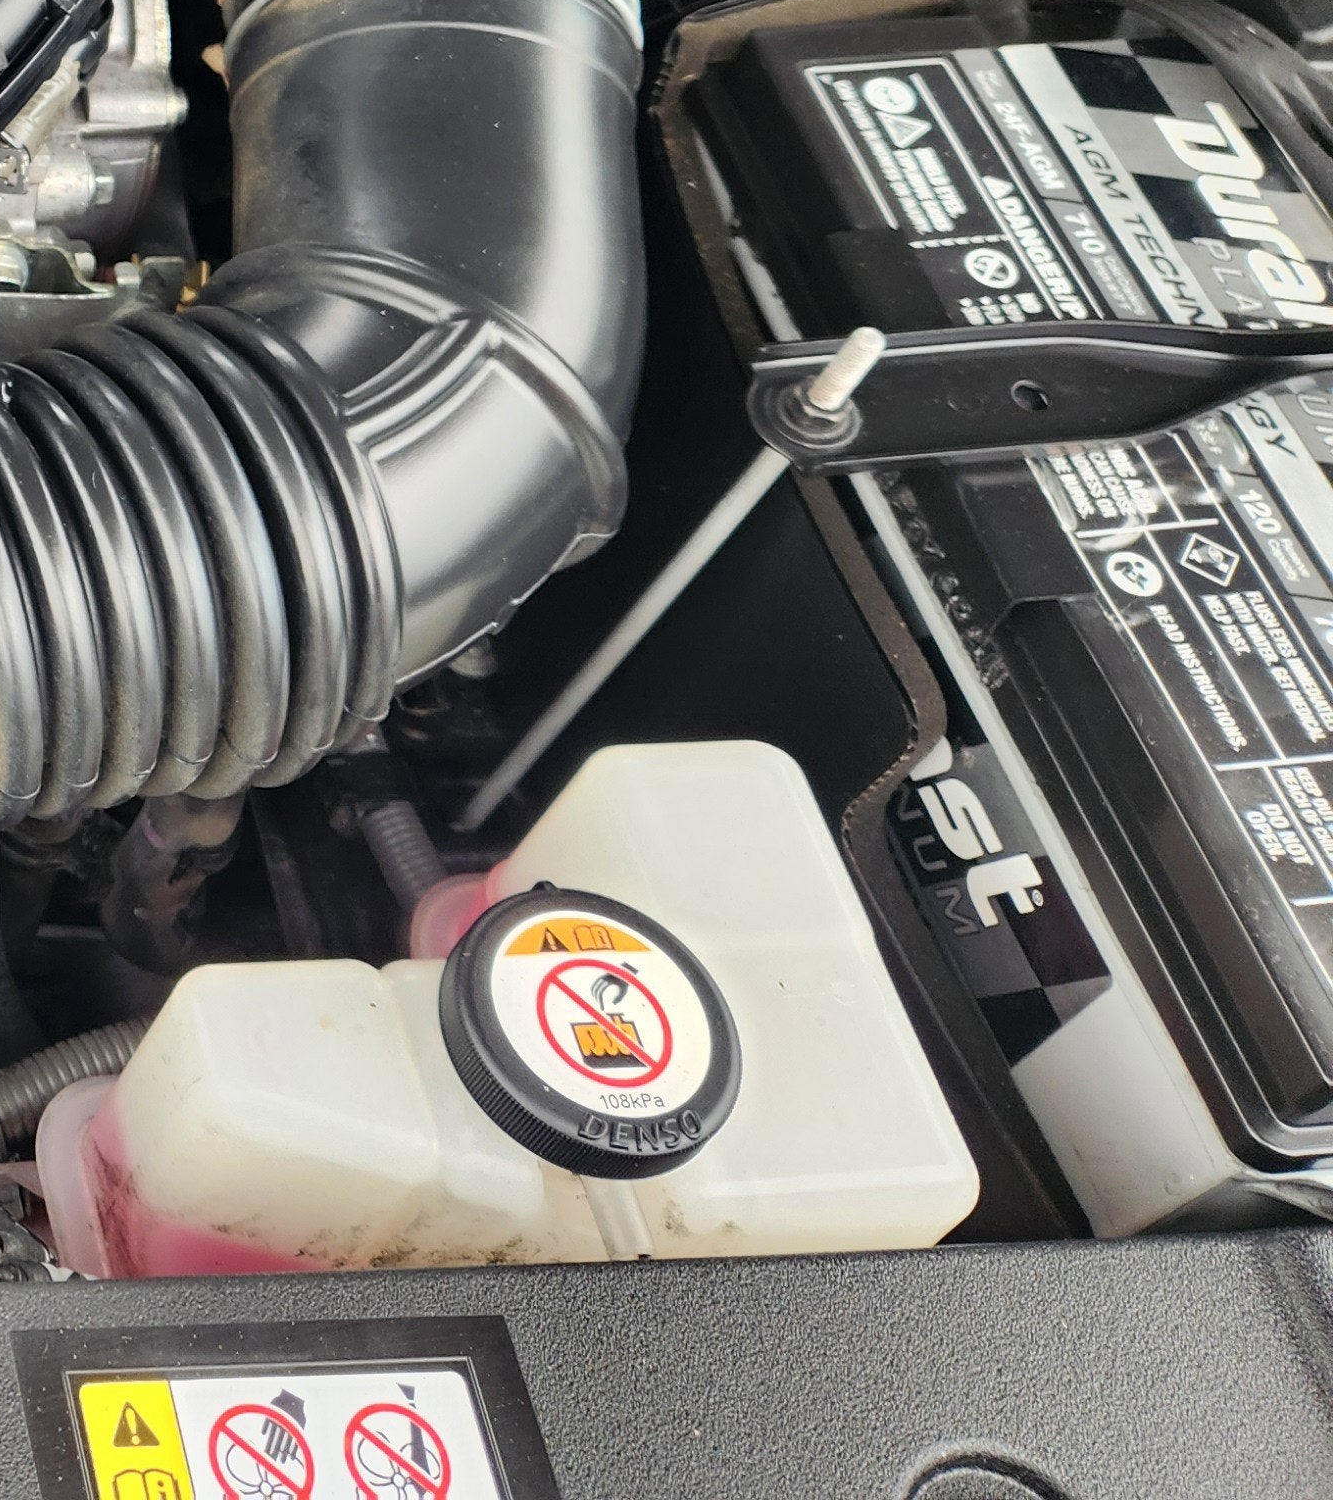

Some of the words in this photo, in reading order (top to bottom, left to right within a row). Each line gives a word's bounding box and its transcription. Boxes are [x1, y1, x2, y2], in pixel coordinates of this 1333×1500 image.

[1063, 125, 1132, 200] AGM
[1063, 210, 1108, 256] 710
[1152, 101, 1333, 327] Dural
[1235, 491, 1282, 534] 120
[1201, 595, 1232, 624] HELP
[1245, 591, 1280, 628] FLUSH
[1267, 628, 1298, 658] EYES
[1149, 605, 1186, 641] READ
[1172, 641, 1248, 752] INSTRUCTIONS.
[1225, 593, 1256, 622] WITH
[1270, 666, 1297, 690] GET
[1284, 690, 1326, 743] MEDICAL
[1277, 770, 1312, 808] REACH
[1300, 810, 1322, 827] OF
[1293, 767, 1324, 797] KEEP
[1243, 811, 1287, 863] OPEN.
[1261, 803, 1290, 829] DO
[1277, 830, 1314, 864] NOT
[599, 1093, 666, 1110] 108kPa
[578, 1109, 702, 1151] DENSO
